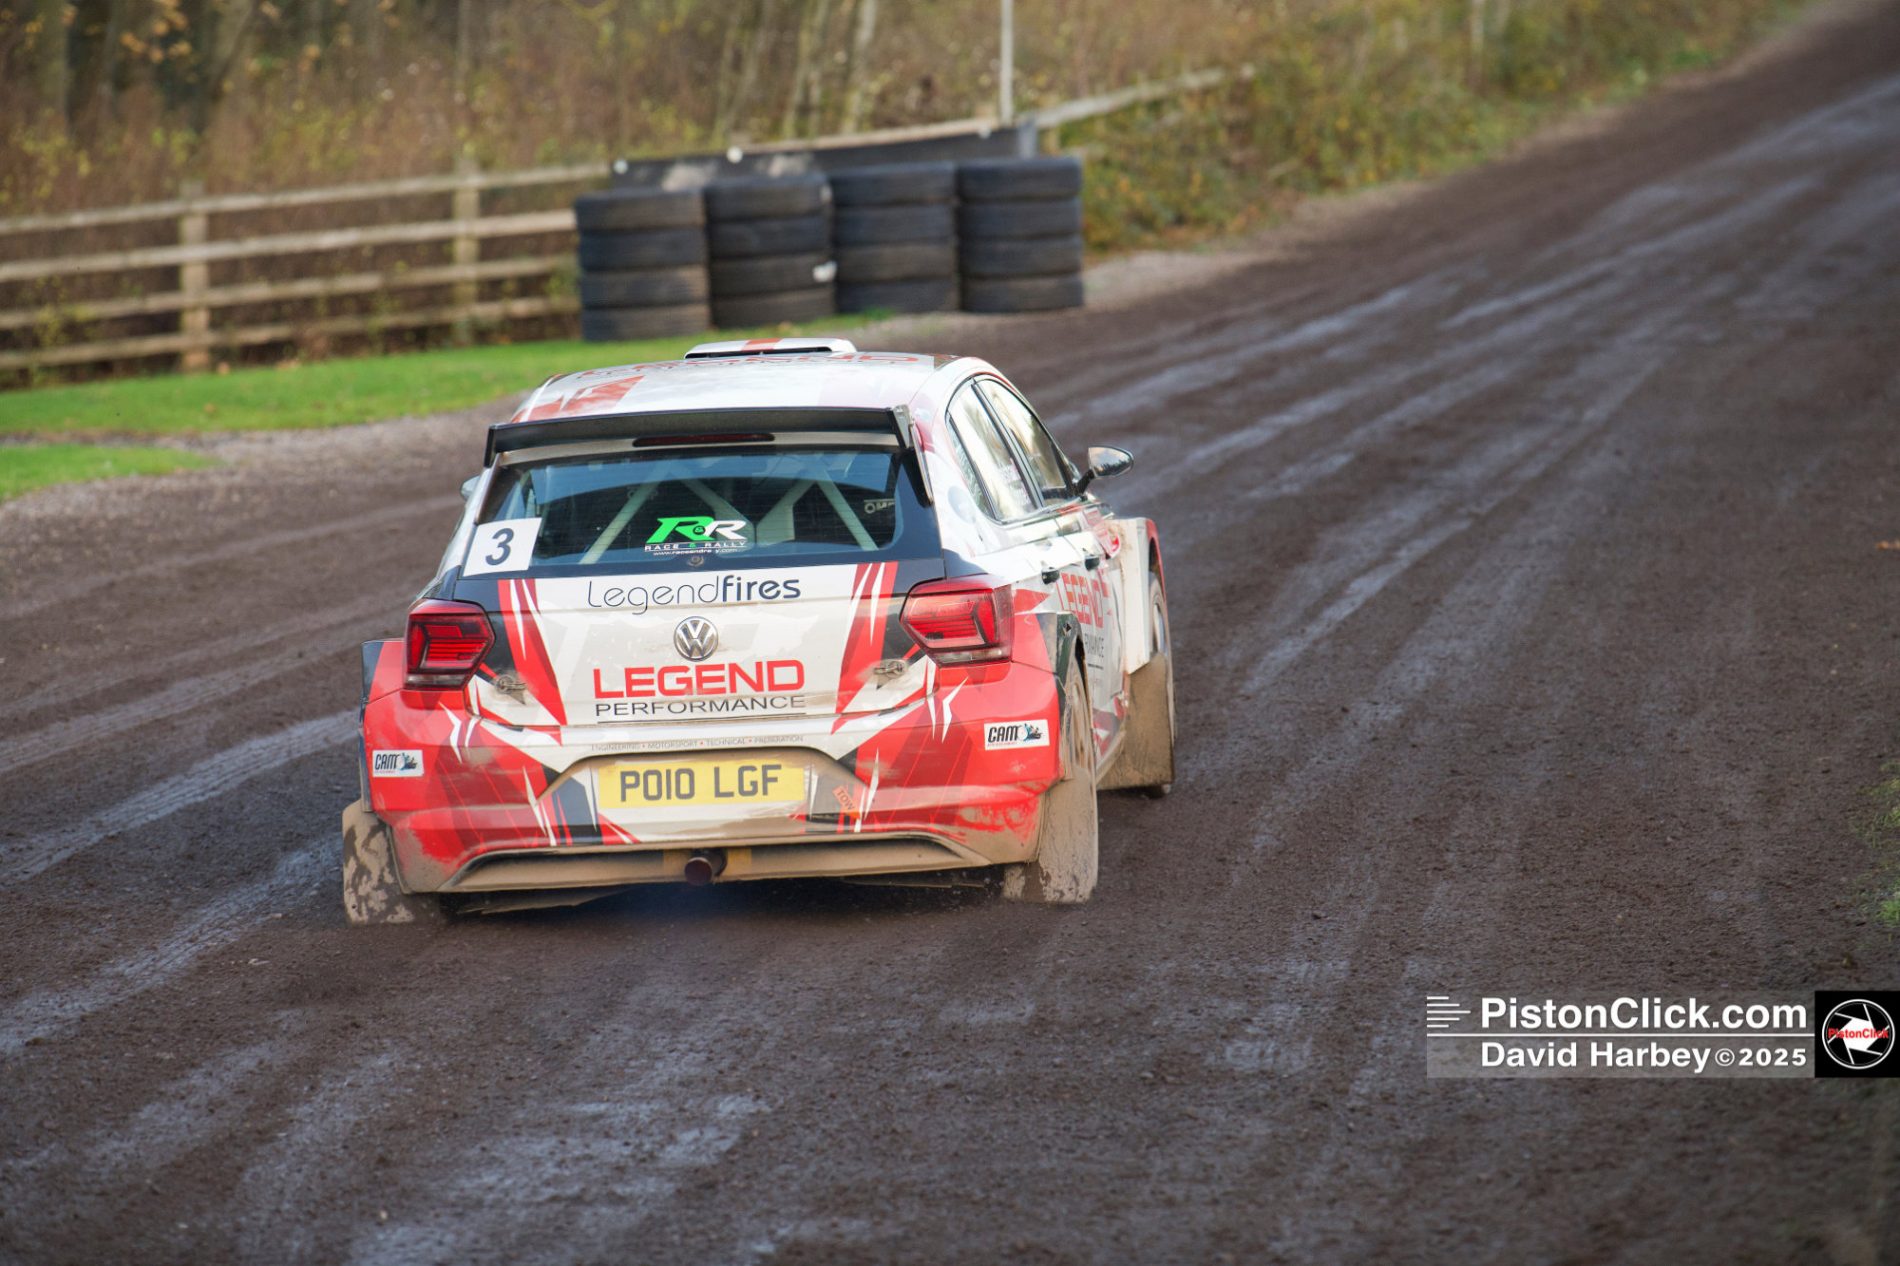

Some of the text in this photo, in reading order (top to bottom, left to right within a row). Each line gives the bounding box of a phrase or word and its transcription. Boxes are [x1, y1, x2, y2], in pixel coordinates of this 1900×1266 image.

[485, 527, 515, 567] 3
[593, 659, 805, 699] LEGEND
[595, 695, 806, 717] PERFORMANCE
[648, 740, 698, 749] MOTORSPORT
[706, 737, 745, 747] TECHNICAL
[988, 725, 1021, 743] CAM
[375, 754, 401, 770] CAM
[620, 764, 782, 802] PO10 LGF
[837, 790, 855, 810] TOW
